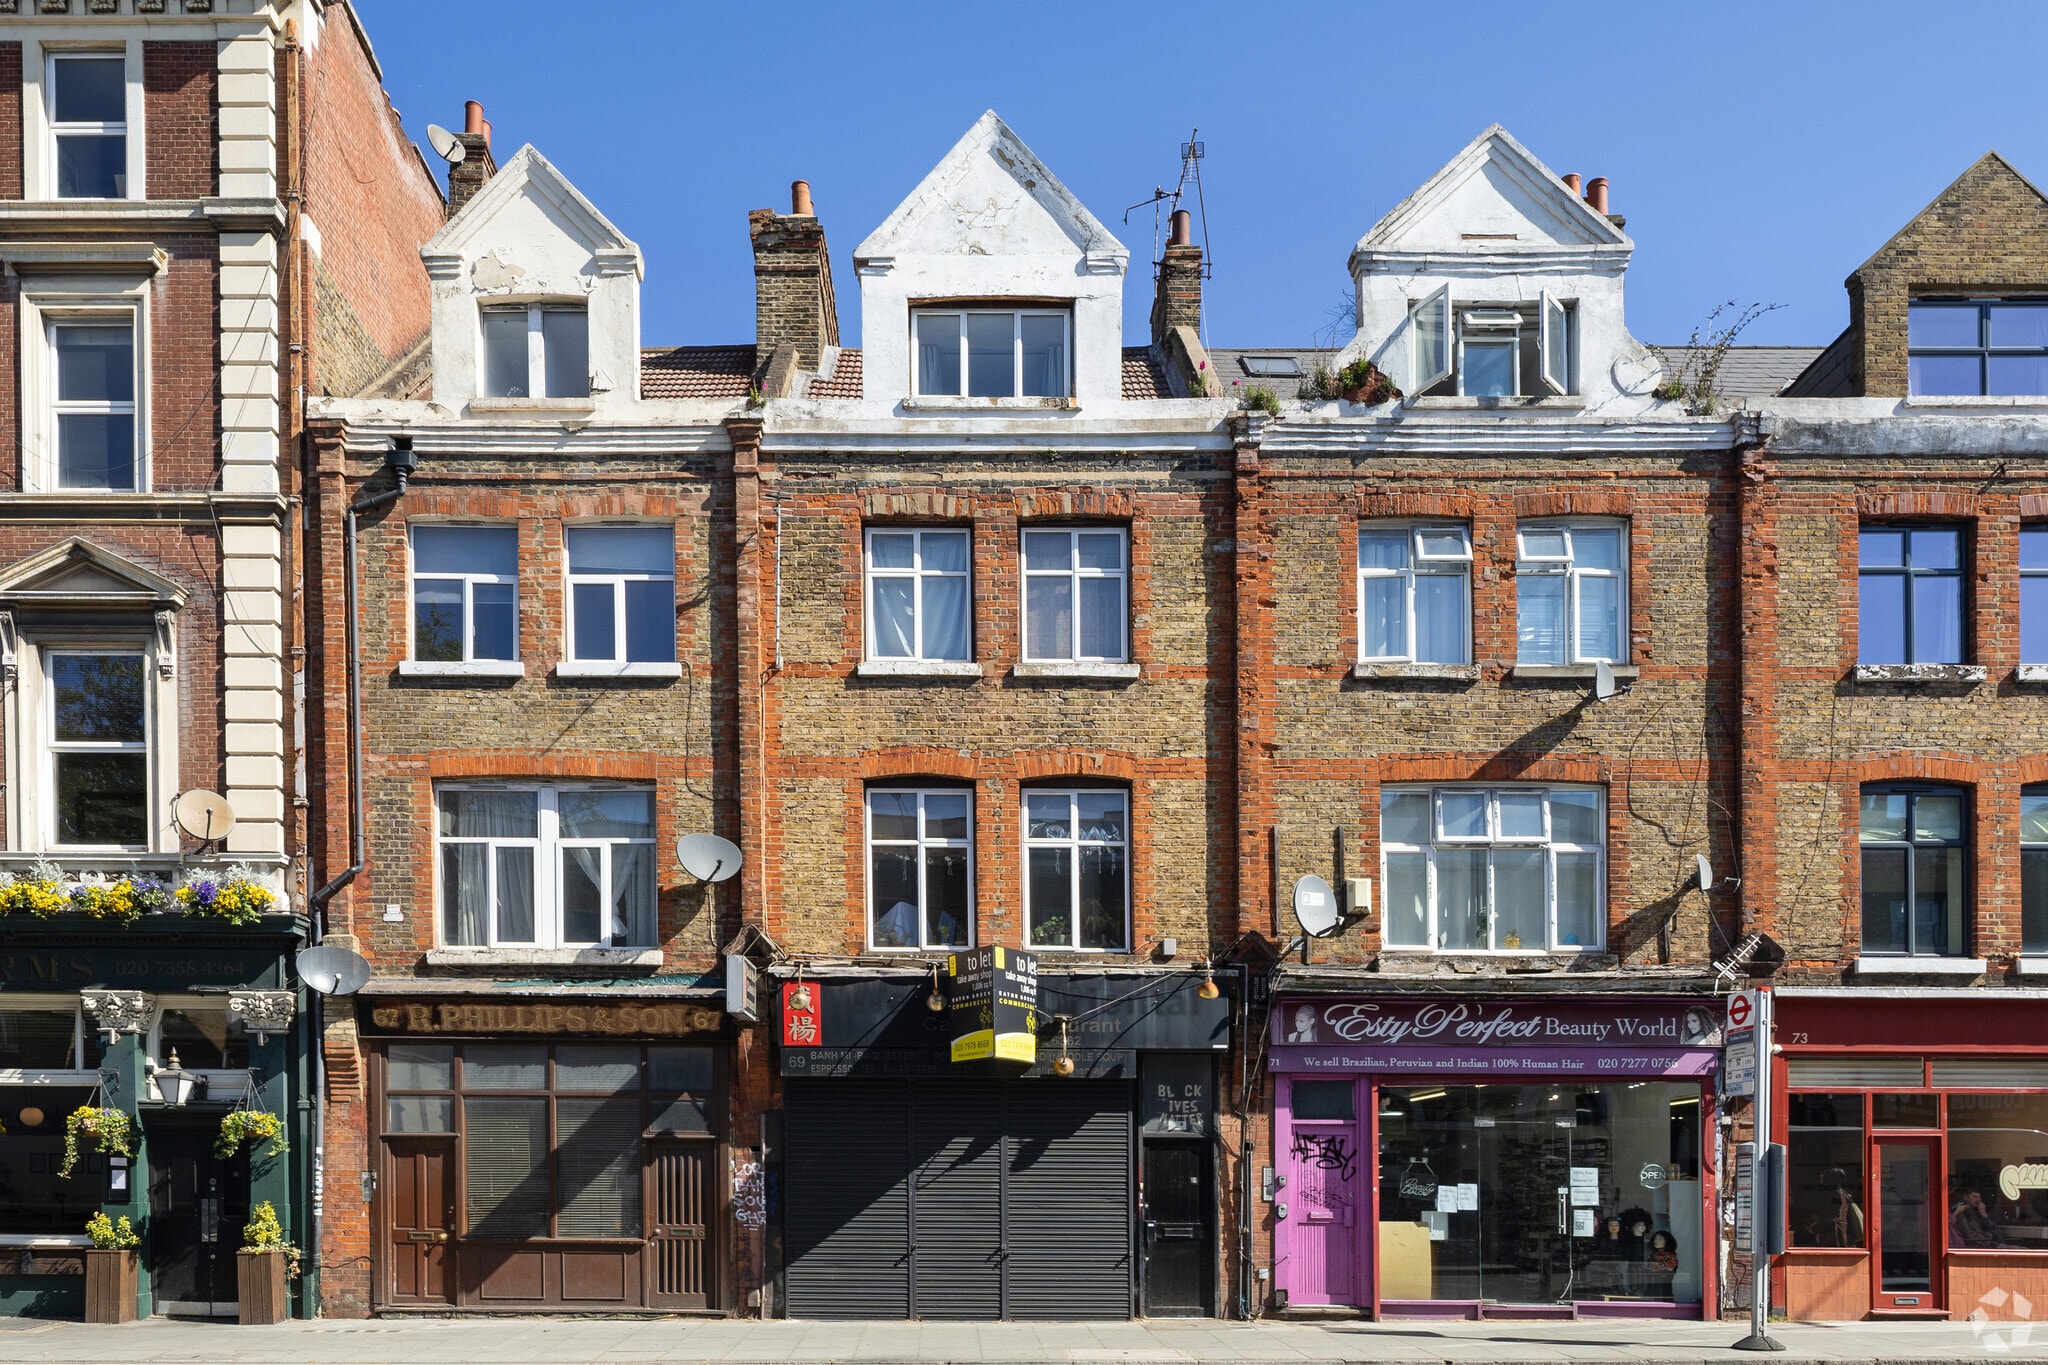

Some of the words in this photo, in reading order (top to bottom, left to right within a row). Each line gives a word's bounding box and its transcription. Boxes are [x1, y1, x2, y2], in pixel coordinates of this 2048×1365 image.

[967, 956, 978, 971] to
[979, 951, 992, 968] let
[1016, 956, 1026, 972] to
[1027, 956, 1037, 975] let
[116, 961, 149, 976] 020
[155, 961, 196, 976] 7358
[203, 961, 245, 976] 4364
[957, 974, 967, 984] take
[968, 973, 979, 982] away
[980, 970, 993, 980] shop
[1005, 970, 1016, 981] take
[1017, 974, 1028, 985] away
[952, 995, 970, 1003] EATON
[971, 991, 991, 999] GREEN
[998, 990, 1019, 999] EATON
[1020, 995, 1036, 1003] GREEN
[952, 998, 991, 1010] COMMERCIAL
[998, 998, 1035, 1011] COMMERCIAL
[374, 1008, 401, 1028] 67
[593, 1009, 612, 1031] &
[695, 1012, 720, 1031] 67
[1324, 1004, 1414, 1044] Esty
[1544, 1018, 1611, 1041] Beauty
[1615, 1018, 1677, 1037] World
[1792, 1032, 1808, 1044] 73
[788, 1055, 806, 1068] 69
[810, 1051, 838, 1061] BANH
[1271, 1058, 1280, 1066] 71
[1304, 1057, 1322, 1066] We
[1323, 1057, 1340, 1066] sell
[1342, 1057, 1388, 1068] Brazilian,
[1389, 1058, 1434, 1067] Peruvian
[1435, 1058, 1454, 1067] and
[1457, 1058, 1488, 1067] Indian
[1492, 1059, 1519, 1068] 100%
[1522, 1059, 1559, 1068] Human
[1561, 1059, 1585, 1068] Hair
[1598, 1059, 1618, 1068] 020
[1621, 1059, 1648, 1068] 7277
[1651, 1059, 1678, 1068] 0756
[1640, 1171, 1666, 1182] OPEN
